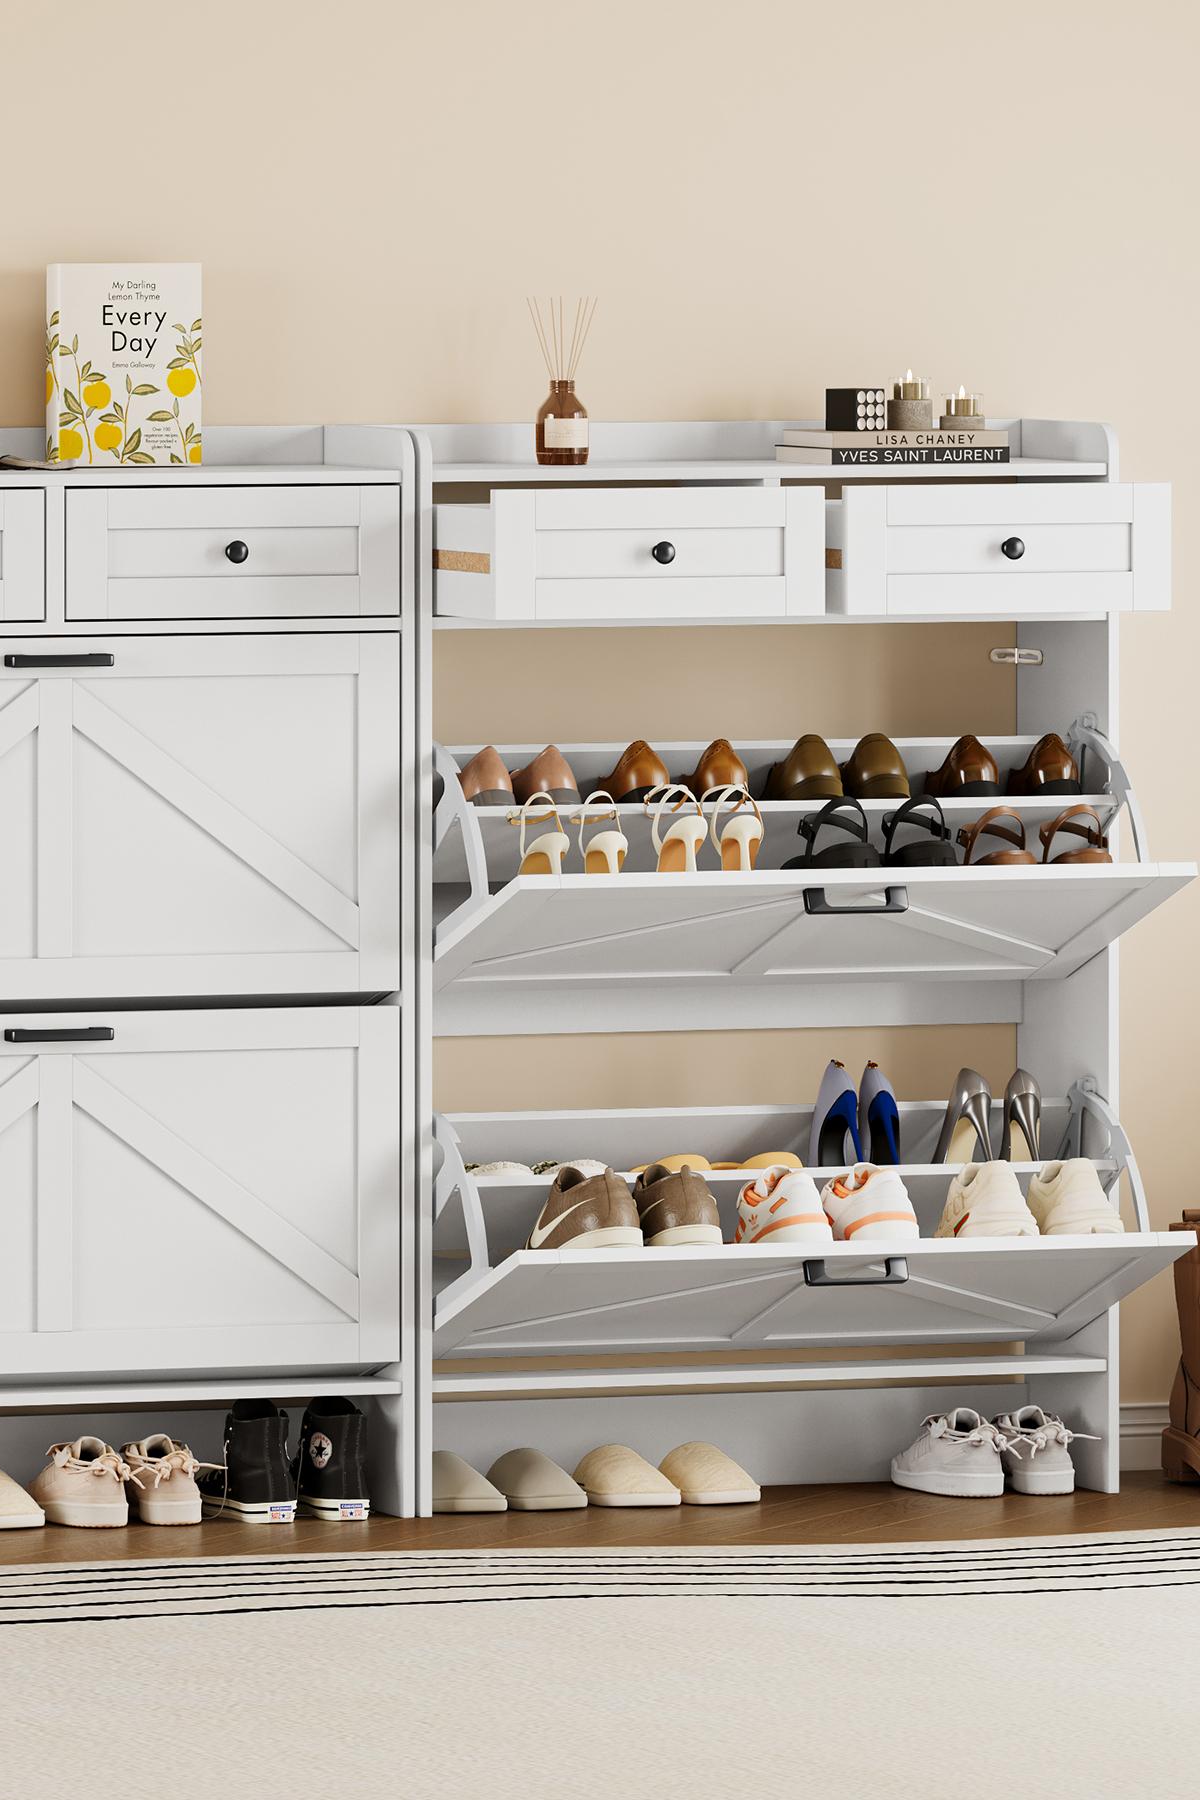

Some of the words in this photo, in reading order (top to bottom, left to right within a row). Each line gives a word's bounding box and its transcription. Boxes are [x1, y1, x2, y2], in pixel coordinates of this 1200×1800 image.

[112, 281, 125, 291] My
[127, 280, 156, 291] Darling
[108, 293, 133, 301] Lemon
[135, 292, 161, 302] Thyme
[103, 305, 167, 332] Every
[112, 331, 158, 358] Day
[876, 435, 908, 446] LISA
[915, 434, 976, 445] CHANEY
[839, 450, 879, 463] YVES
[883, 450, 929, 462] SAINT
[933, 449, 1004, 462] LAURENT
